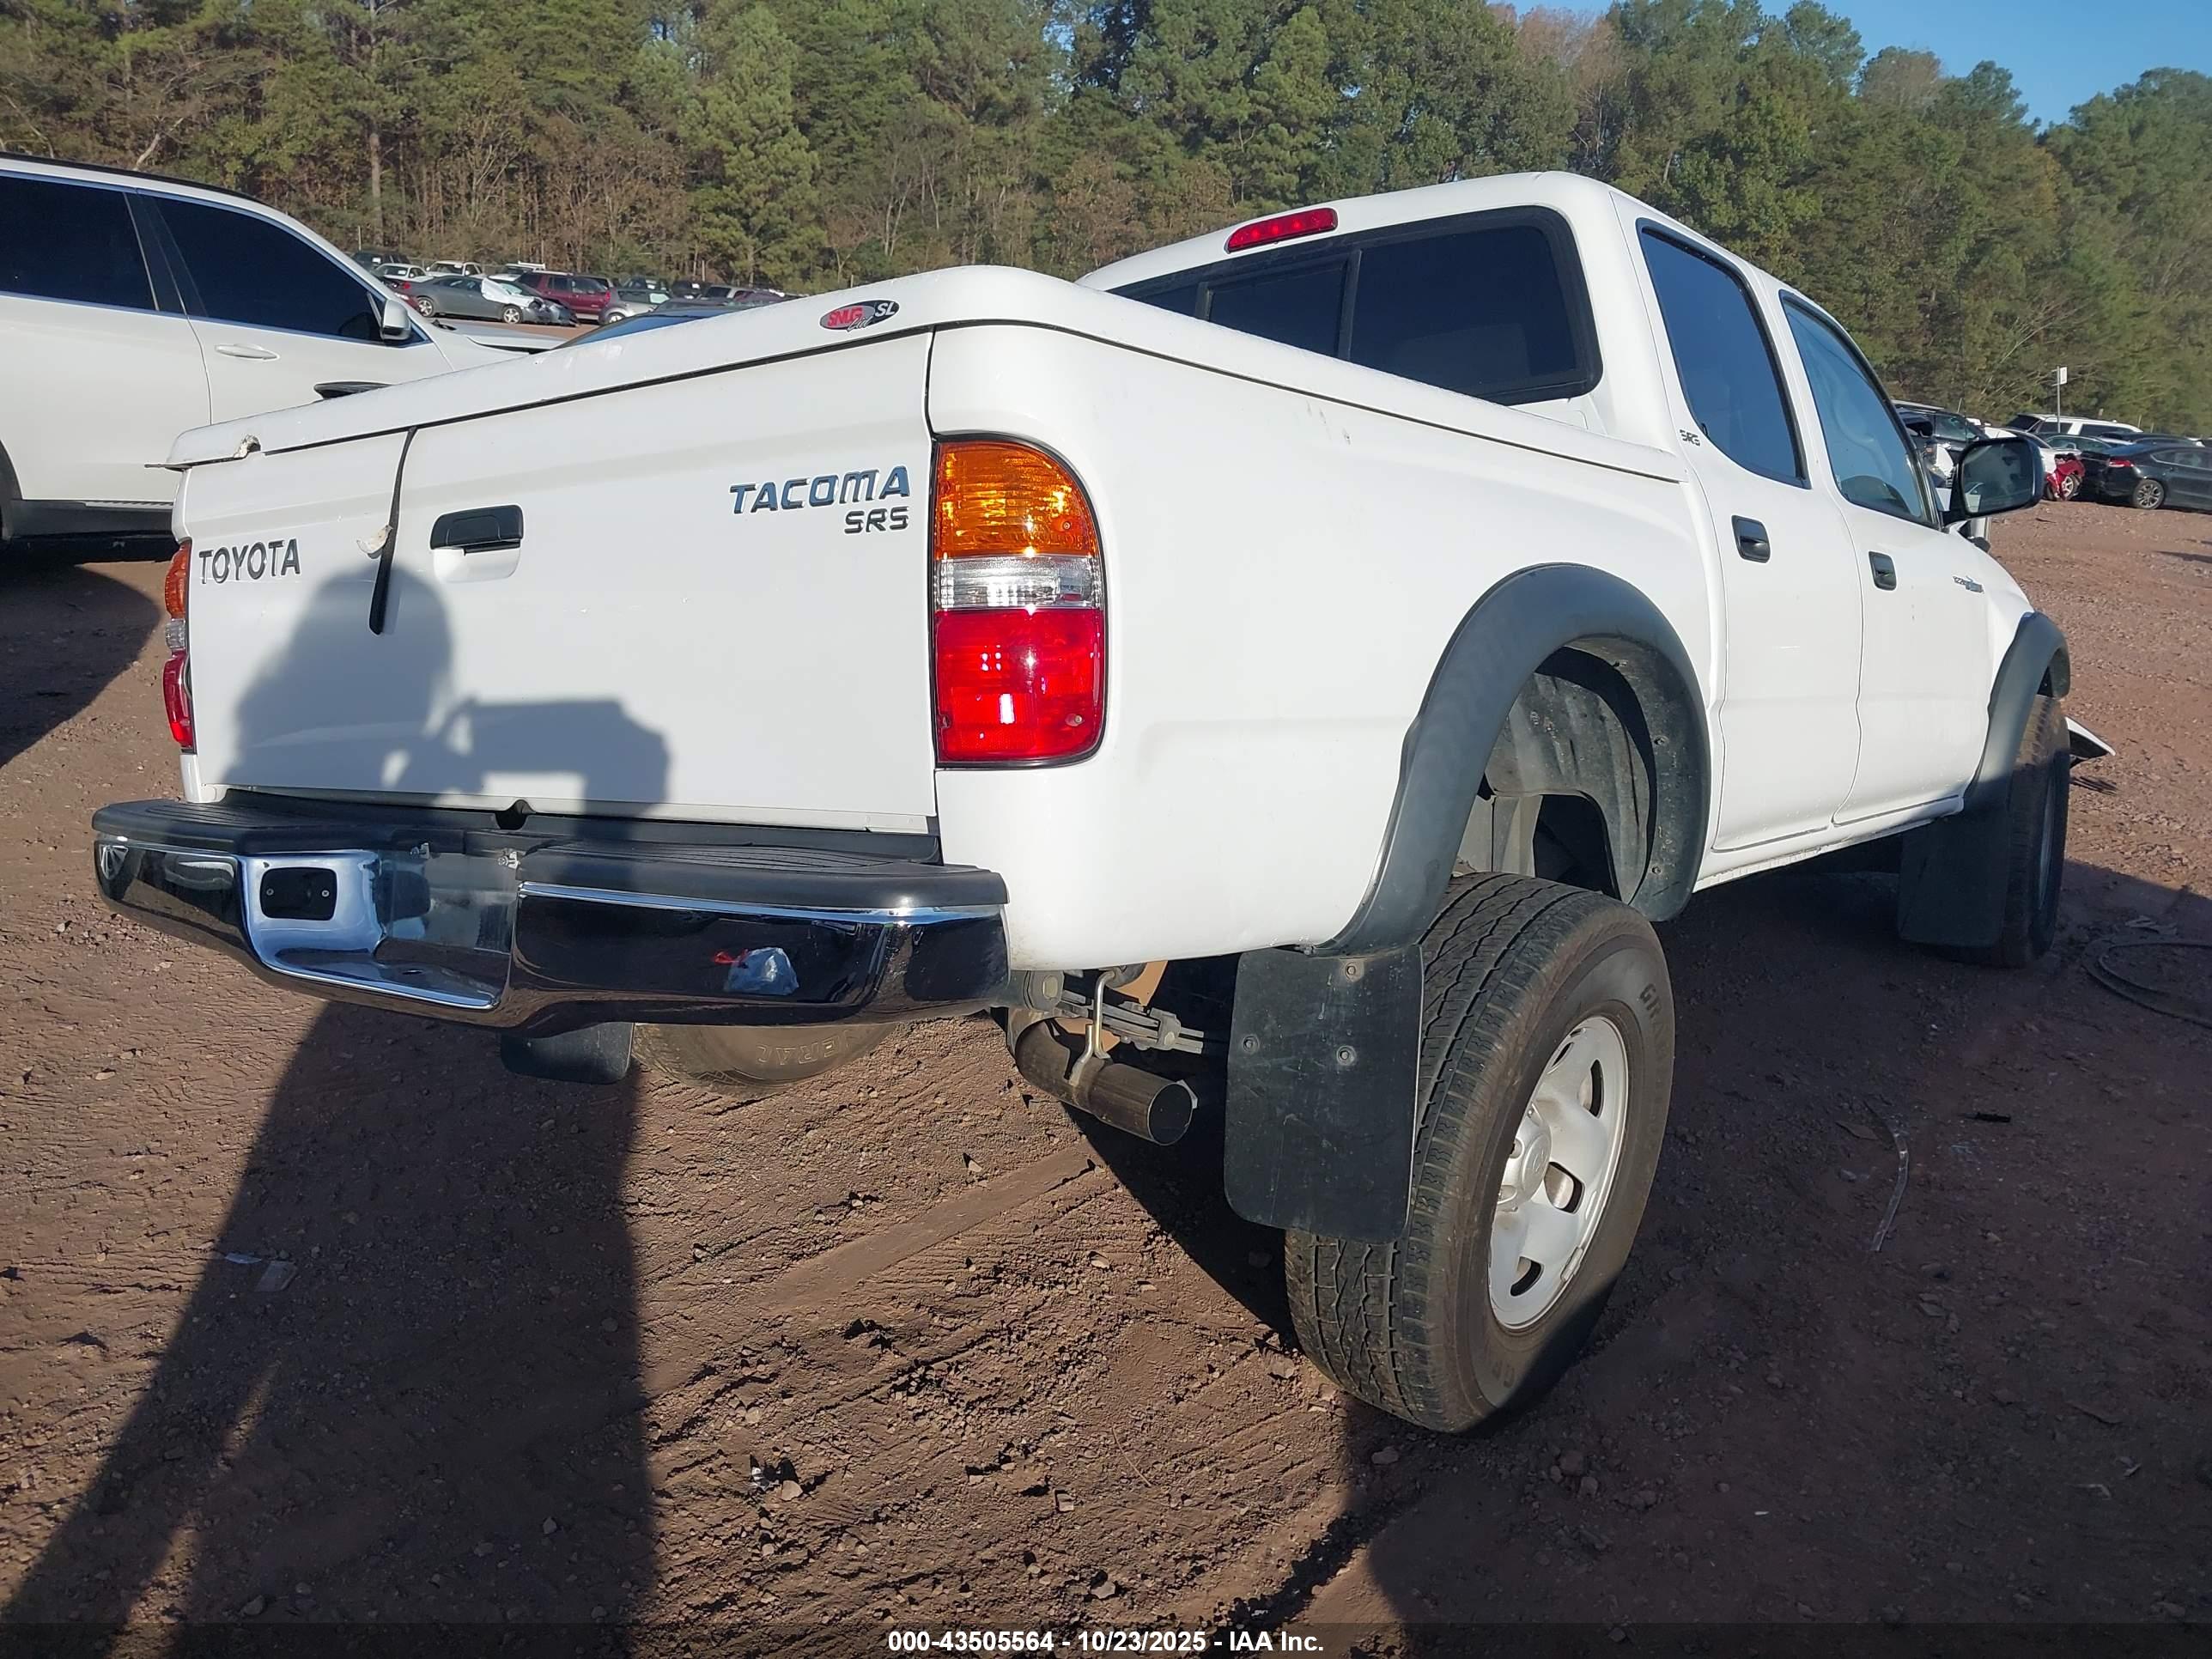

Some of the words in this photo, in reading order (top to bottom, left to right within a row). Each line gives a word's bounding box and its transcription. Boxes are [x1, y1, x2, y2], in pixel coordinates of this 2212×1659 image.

[874, 301, 896, 318] SL
[729, 465, 911, 514] TACOMA
[844, 506, 910, 534] SRS
[198, 538, 301, 585] TOYOTA
